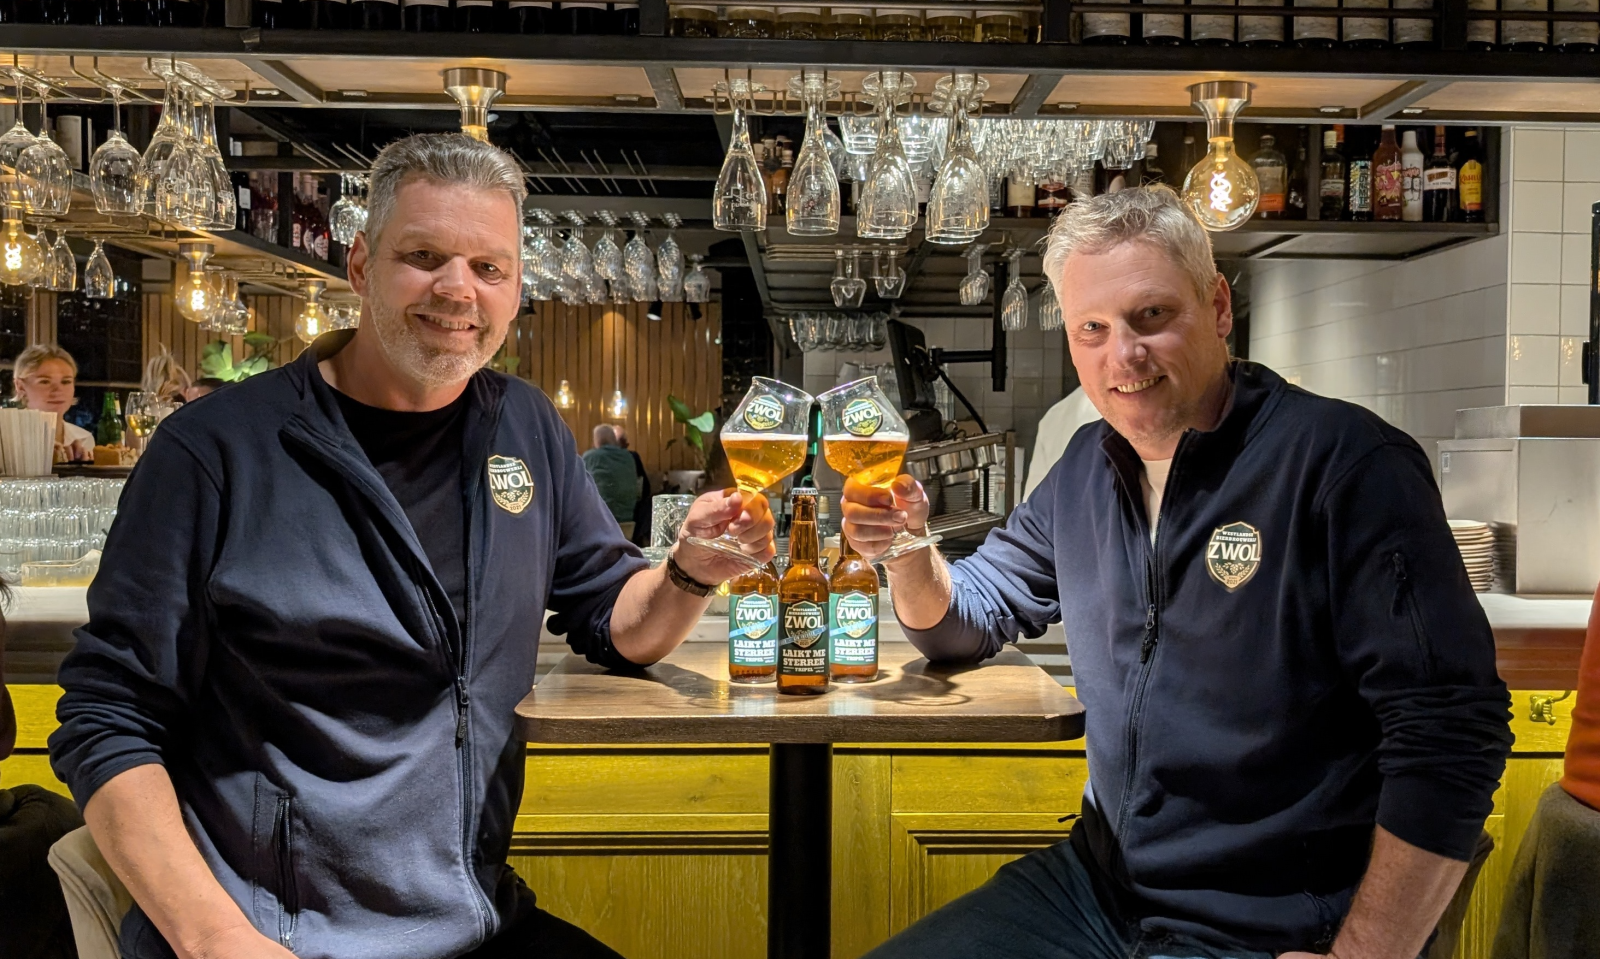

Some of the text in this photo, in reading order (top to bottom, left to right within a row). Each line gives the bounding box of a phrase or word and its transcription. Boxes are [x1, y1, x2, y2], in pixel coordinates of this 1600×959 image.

[746, 402, 783, 423] ZWOL
[842, 406, 882, 427] ZWOL
[1208, 542, 1261, 561] ZWOL
[736, 608, 773, 620] ZWOL
[837, 607, 872, 619] ZWOL
[785, 616, 823, 628] ZWOL
[734, 640, 775, 648] LAIKT ME
[834, 639, 875, 647] LAIKT ME
[734, 648, 774, 656] STERREK
[783, 649, 826, 657] LAIKT ME
[835, 647, 874, 655] STERREK
[783, 658, 825, 666] STERREK
